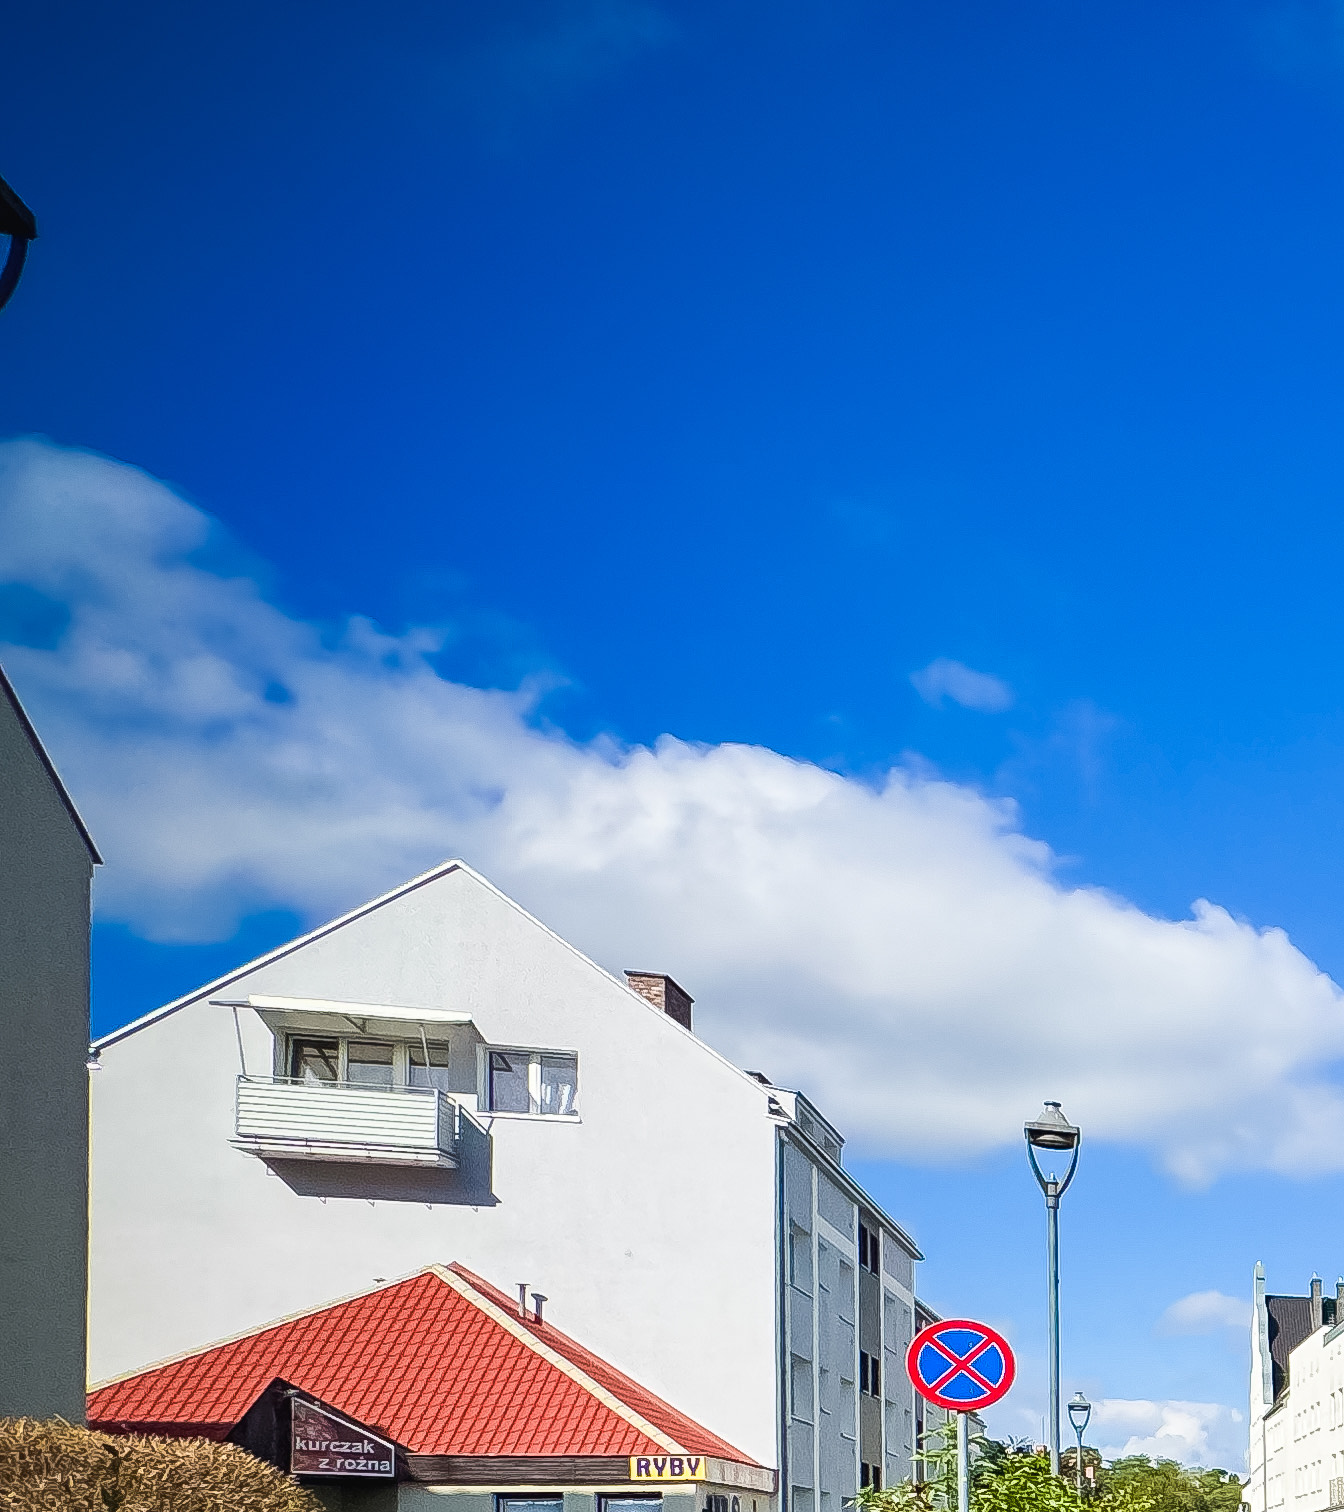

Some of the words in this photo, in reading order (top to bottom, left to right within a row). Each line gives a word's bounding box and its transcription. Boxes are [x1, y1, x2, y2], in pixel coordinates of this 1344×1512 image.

[295, 1437, 375, 1454] kurczak
[318, 1458, 330, 1469] z
[636, 1457, 701, 1477] RYBY
